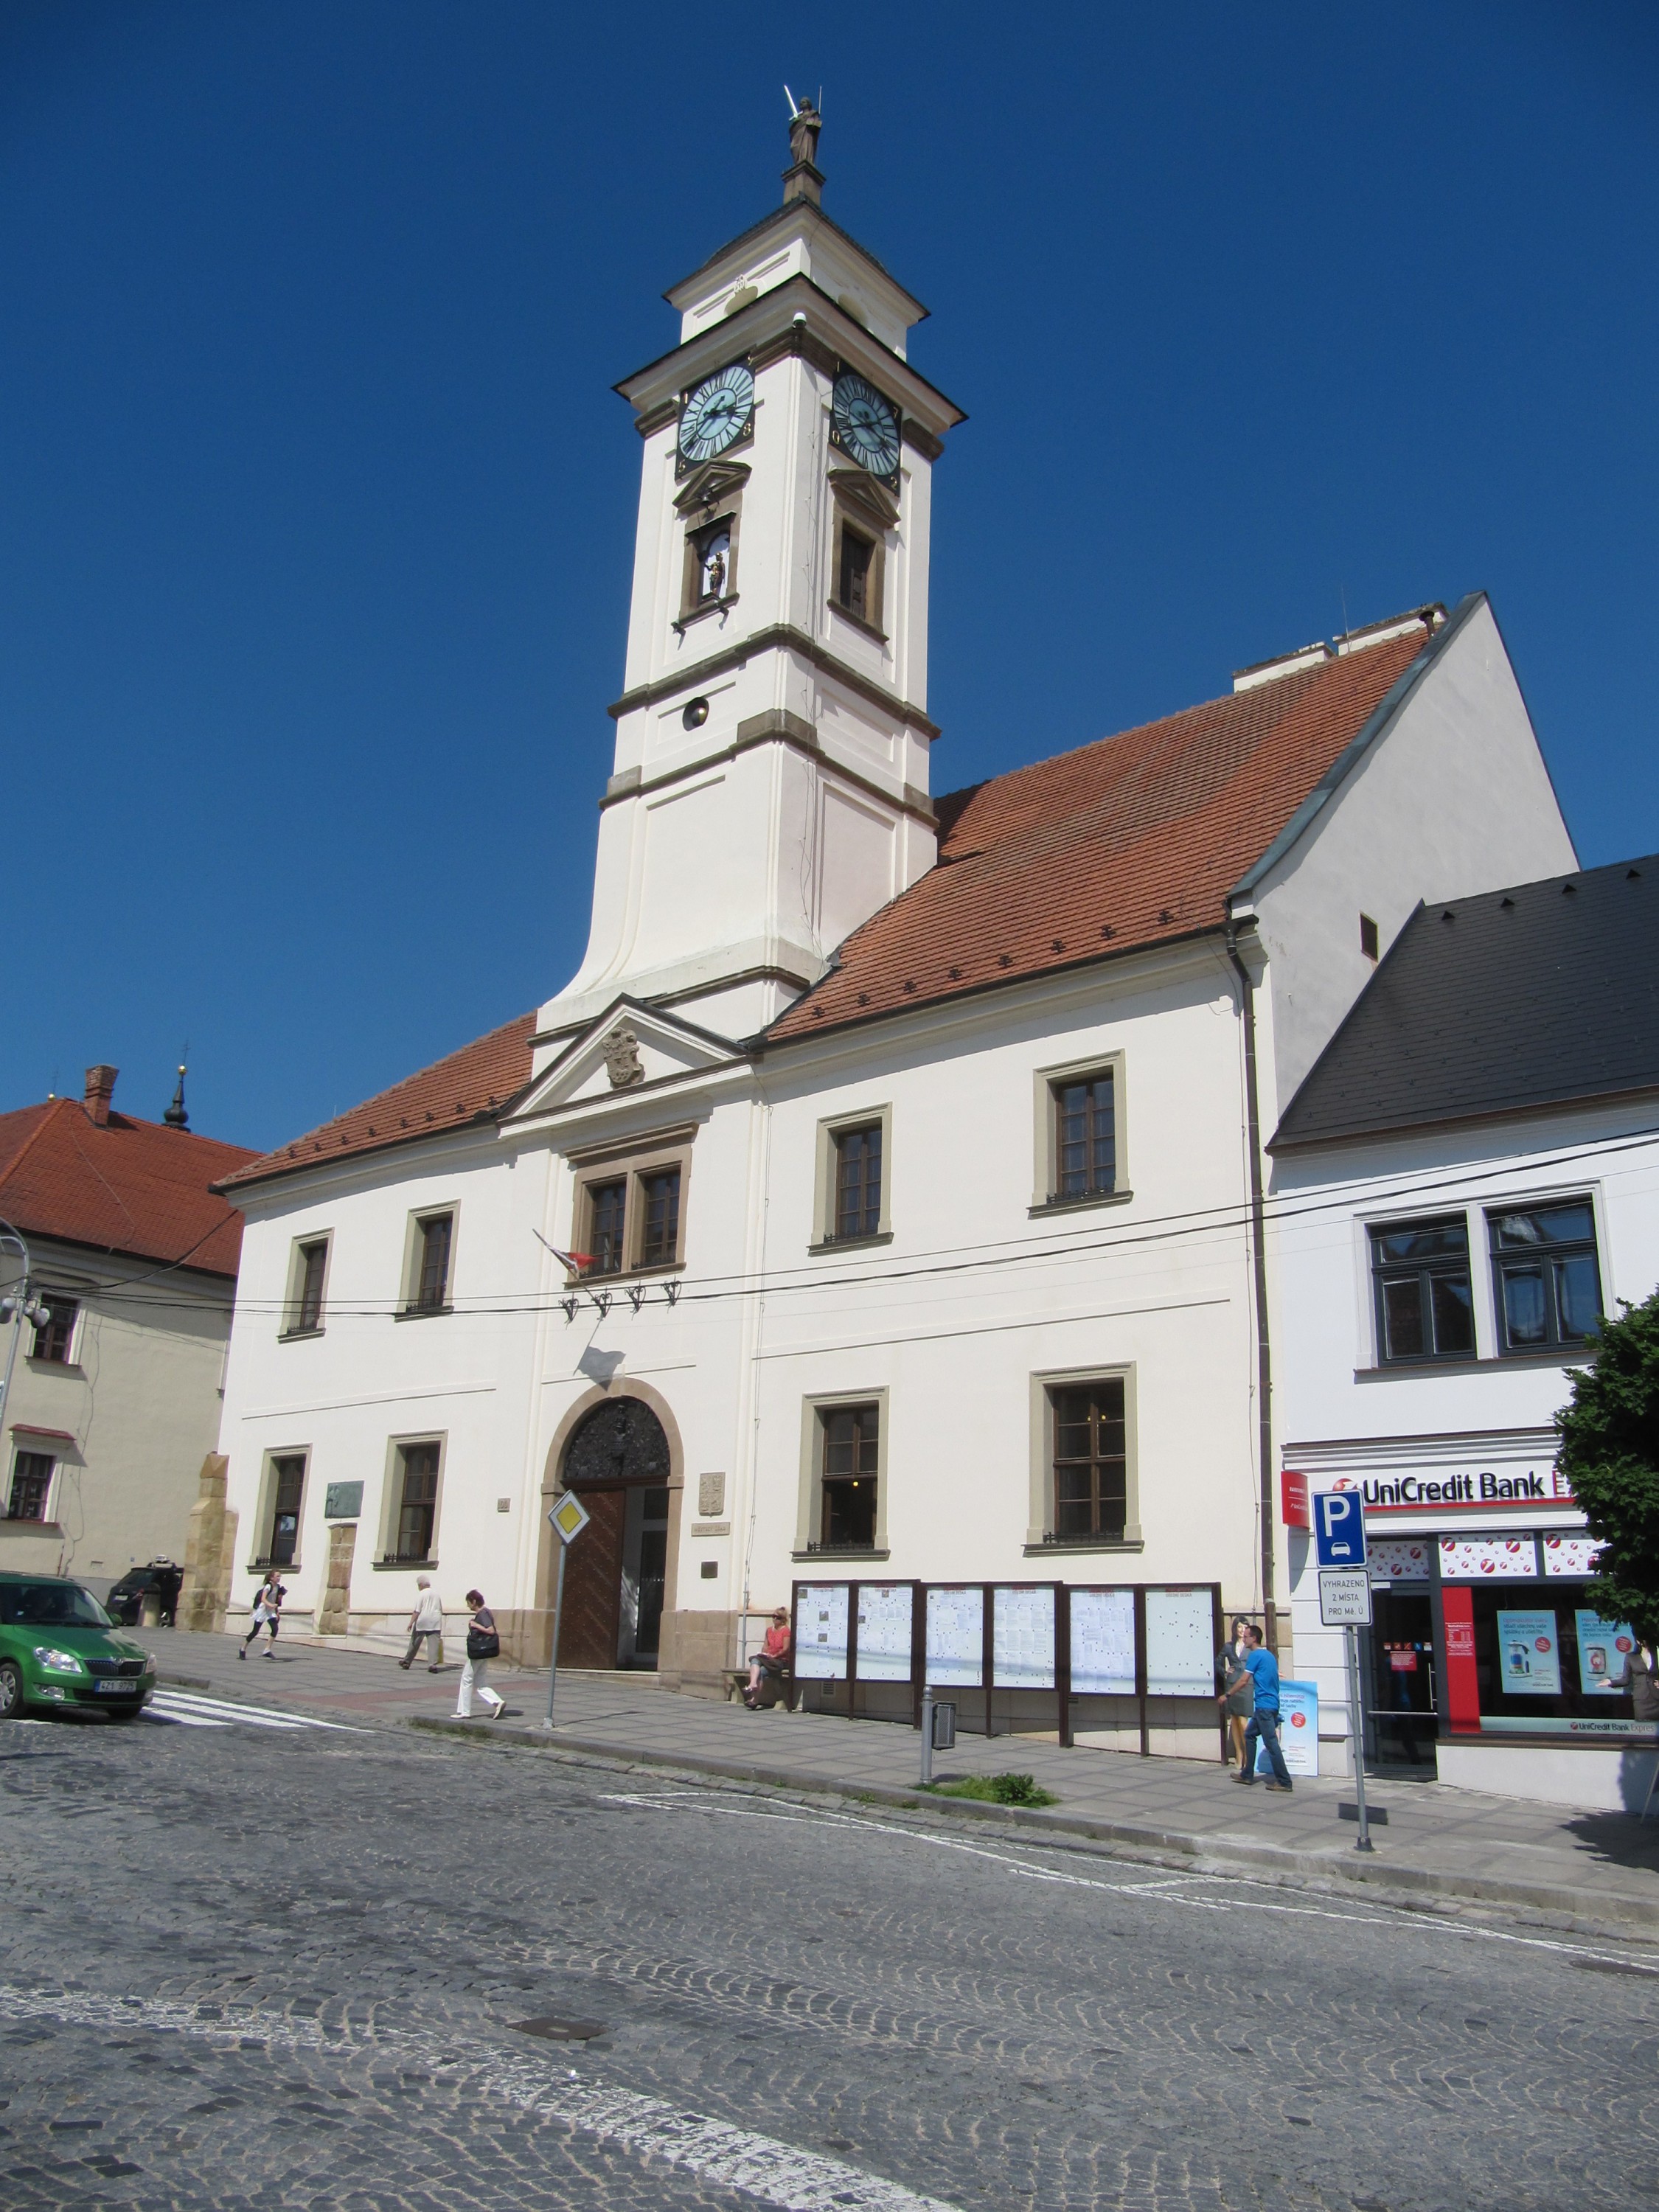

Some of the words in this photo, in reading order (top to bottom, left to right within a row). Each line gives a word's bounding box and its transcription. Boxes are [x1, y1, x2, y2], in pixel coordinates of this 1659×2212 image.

[1363, 1474, 1474, 1503] UniCredit
[1479, 1471, 1546, 1499] Bank
[1322, 1495, 1351, 1537] P
[1323, 1580, 1365, 1588] VYHRAZENO
[1332, 1593, 1337, 1601] 2
[1339, 1592, 1360, 1601] MÍSTA
[1329, 1607, 1342, 1615] PRO
[1612, 1723, 1630, 1731] Bank
